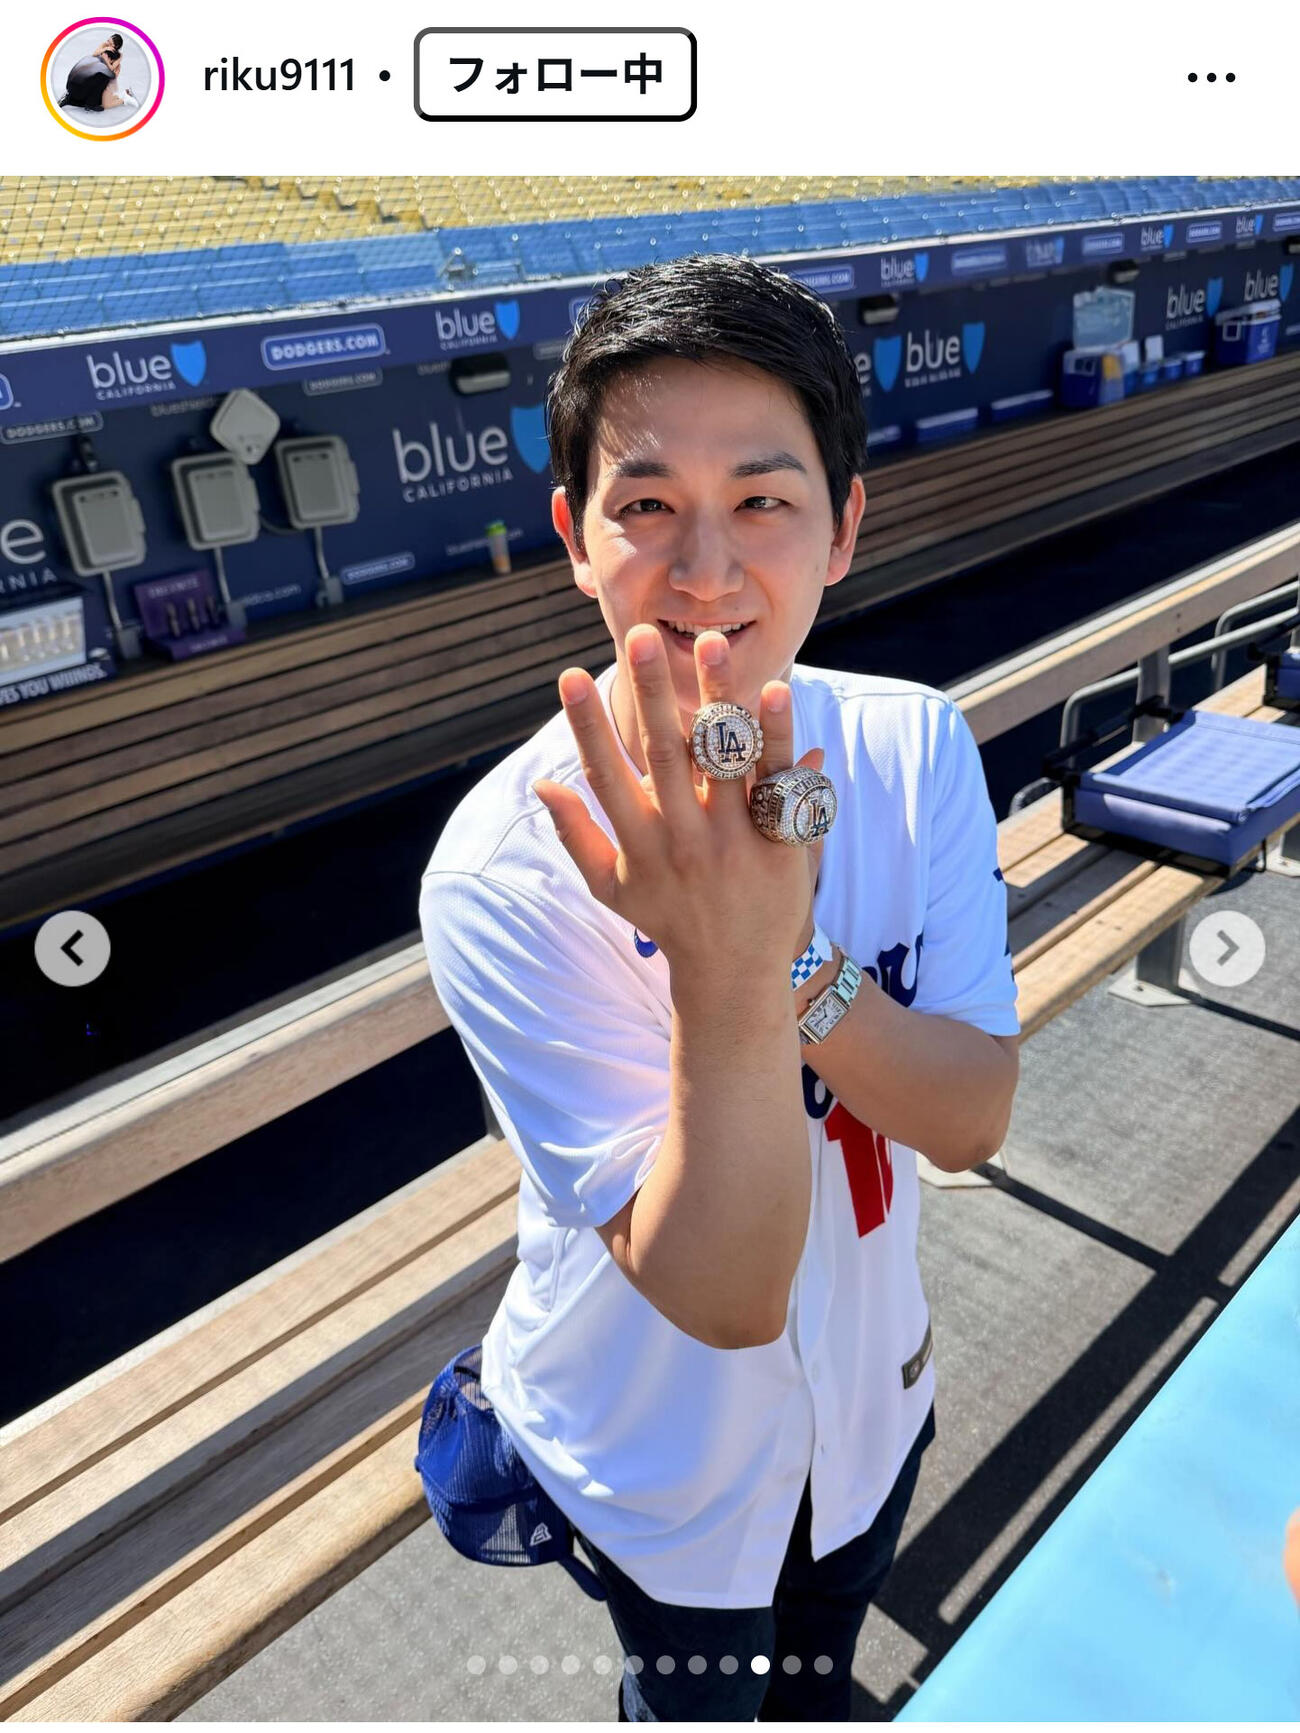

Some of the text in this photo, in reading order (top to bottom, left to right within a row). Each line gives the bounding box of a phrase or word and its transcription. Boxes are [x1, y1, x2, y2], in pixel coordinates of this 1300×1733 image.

[881, 255, 915, 281] blue
[1166, 283, 1206, 320] blue
[1244, 269, 1278, 301] blue
[435, 308, 497, 341] blue
[270, 334, 380, 361] DODGERS.COM
[86, 351, 173, 390] blue
[96, 381, 177, 400] CALIFORNIA
[393, 421, 509, 484] blue
[402, 468, 514, 503] CALIFORNIA
[19, 677, 50, 699] YOU
[716, 722, 746, 763] LA
